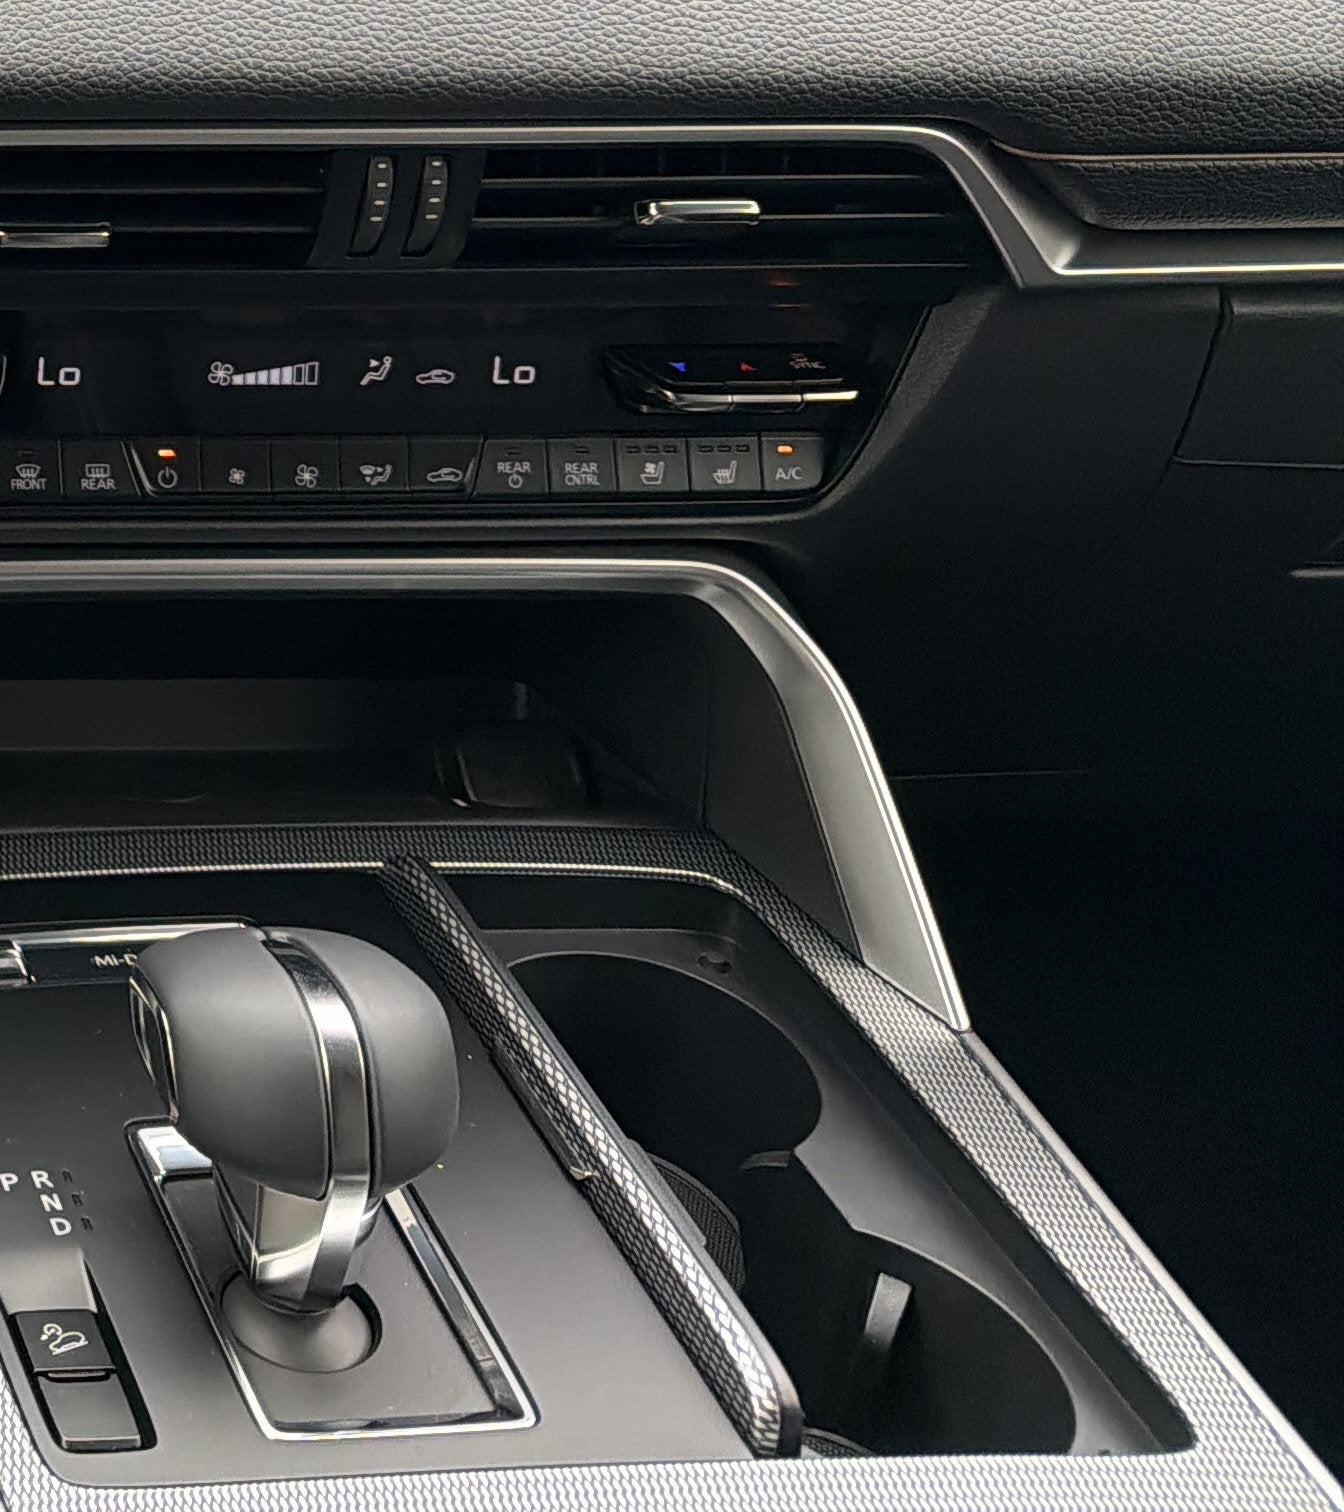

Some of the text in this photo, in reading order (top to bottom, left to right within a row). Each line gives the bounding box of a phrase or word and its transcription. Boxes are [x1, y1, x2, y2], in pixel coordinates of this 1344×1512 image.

[36, 355, 82, 387] Lo
[492, 355, 537, 386] Lo
[496, 461, 532, 475] REAR
[564, 461, 598, 475] REAR
[774, 466, 803, 481] A/C
[11, 477, 48, 491] FRONT
[80, 478, 116, 491] REAR
[563, 474, 602, 487] CNTRL
[30, 1169, 55, 1190] R
[39, 1192, 64, 1213] N
[48, 1216, 73, 1237] D
